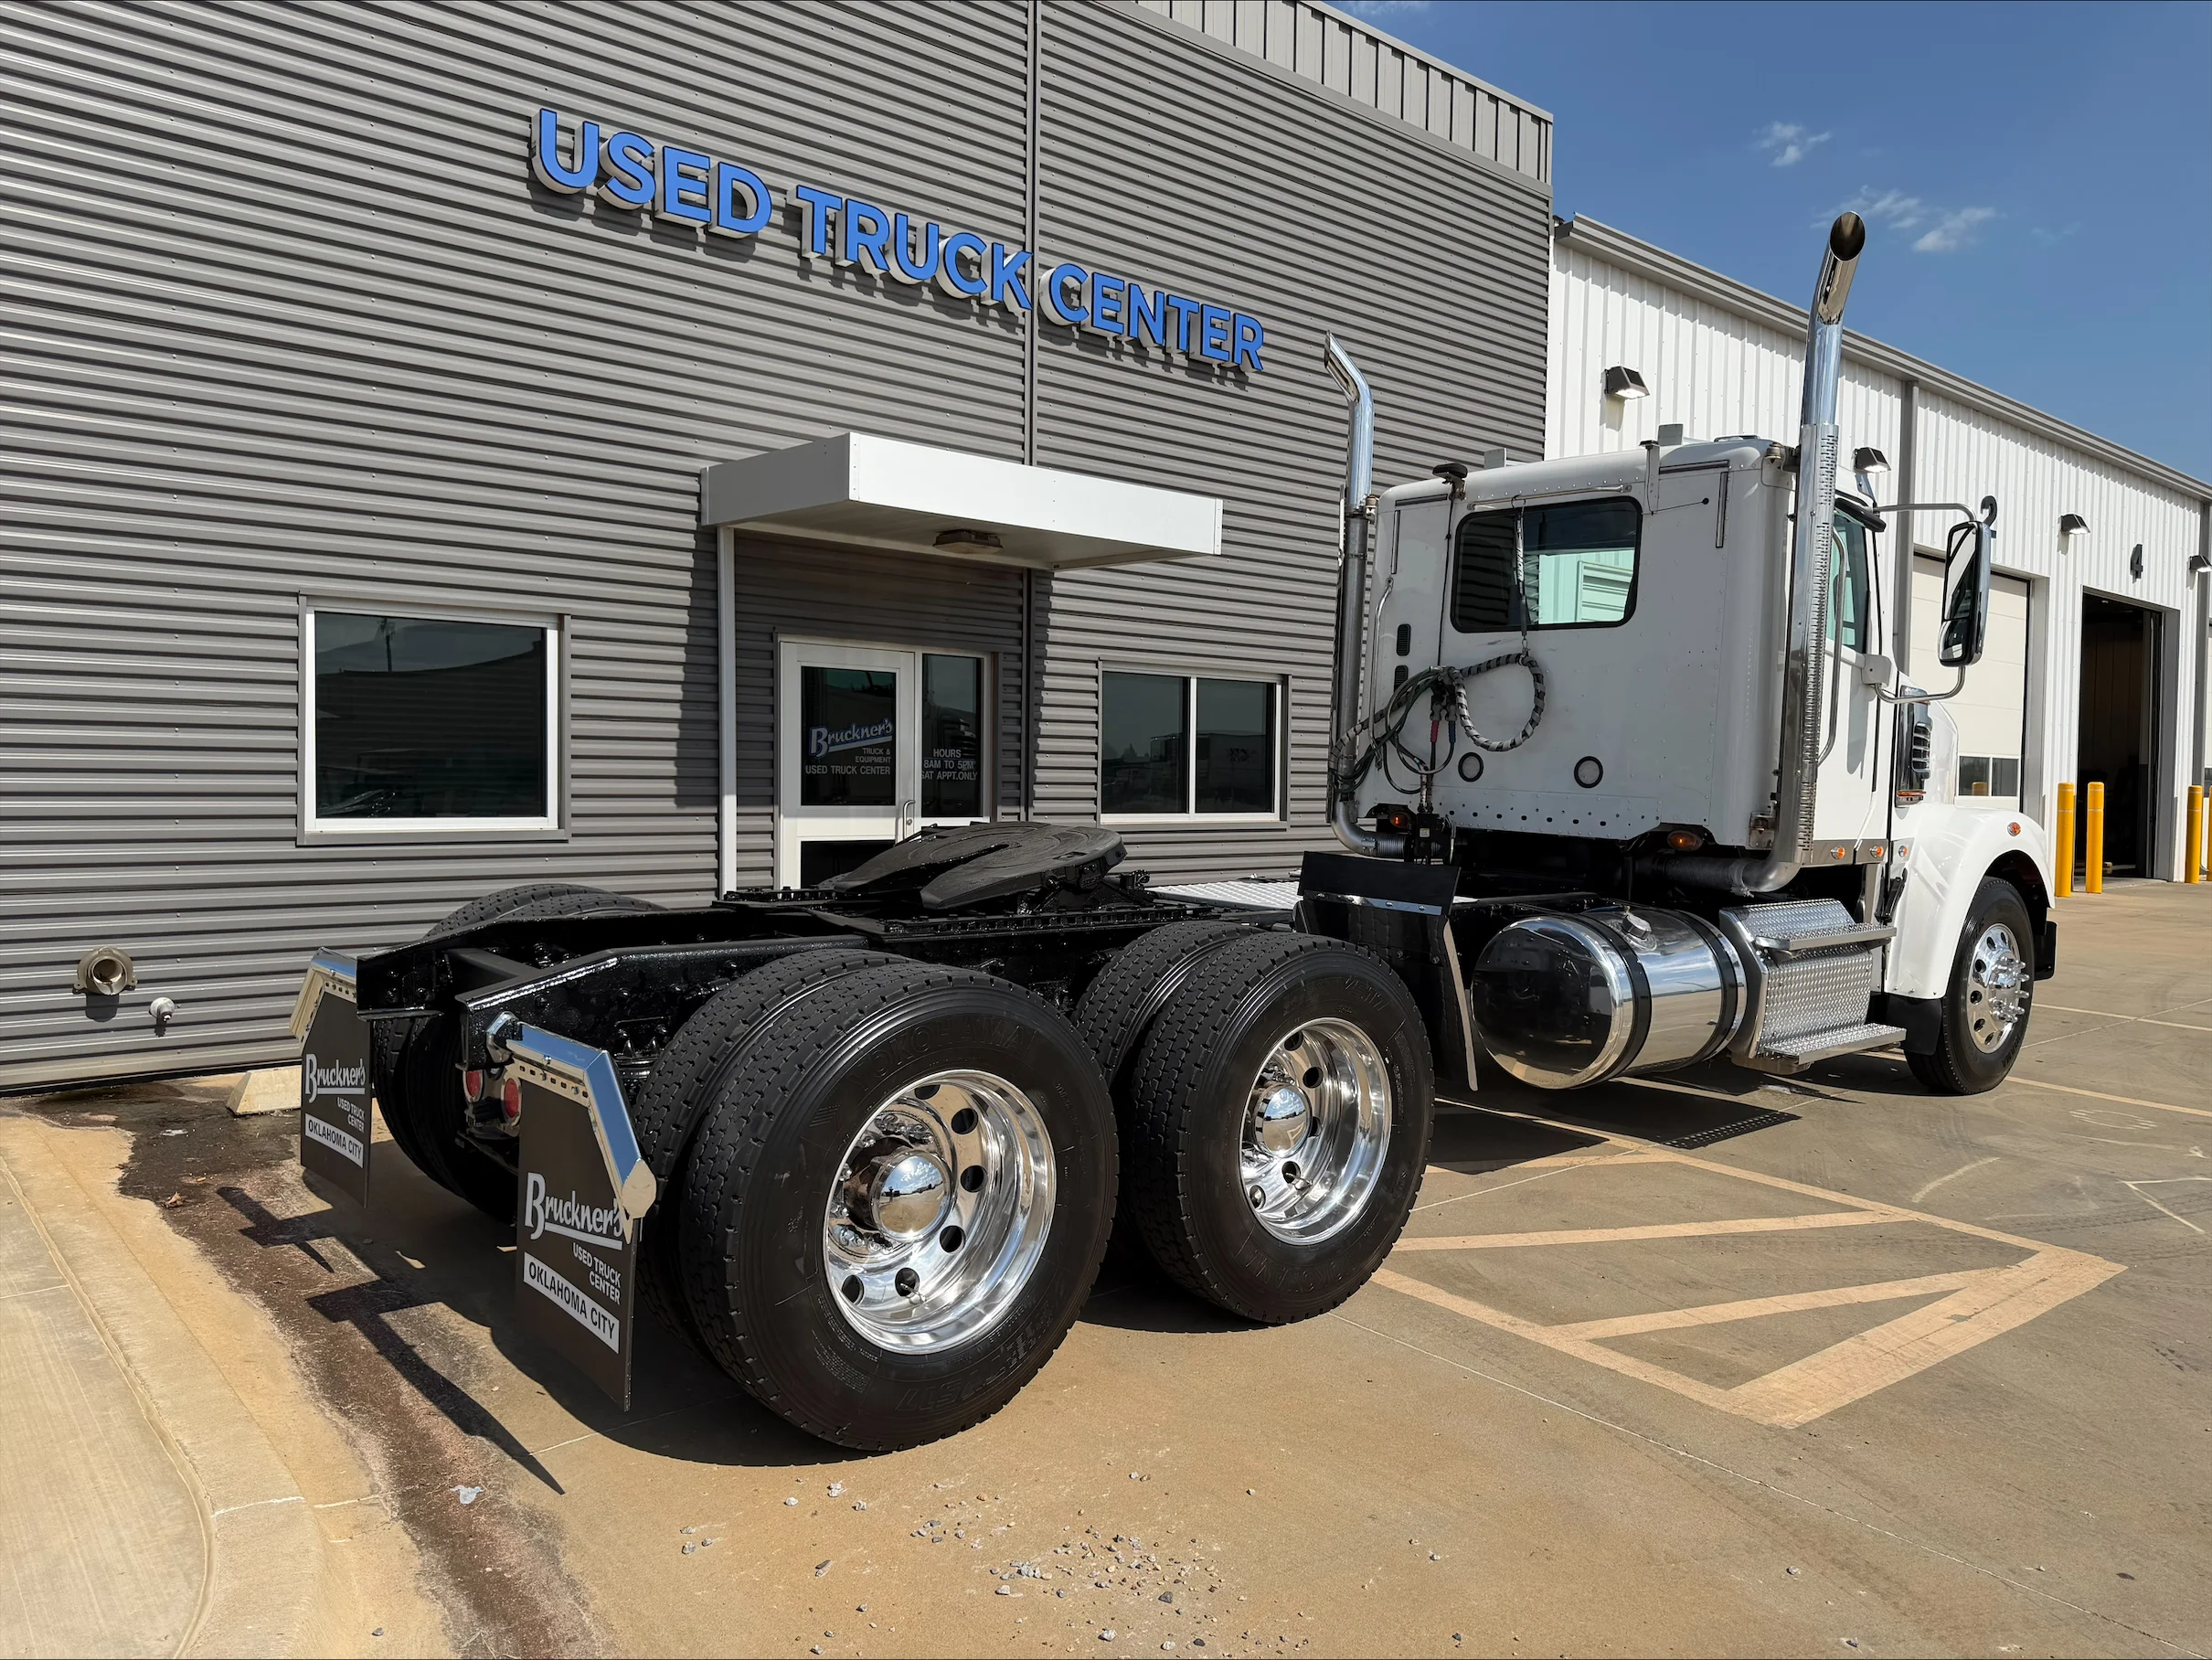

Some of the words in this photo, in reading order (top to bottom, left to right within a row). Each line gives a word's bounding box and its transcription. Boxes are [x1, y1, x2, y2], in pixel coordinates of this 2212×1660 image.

[537, 108, 772, 236] USED
[794, 184, 1034, 311] TRUCK
[1048, 262, 1264, 370] CENTER
[810, 718, 893, 758] Bruckner's
[933, 749, 962, 759] HOURS
[805, 765, 828, 775] USED
[831, 765, 858, 775] TRUCK
[860, 765, 891, 775] CENTER
[855, 756, 891, 765] EQUIPMENT
[924, 760, 941, 769] 8AM
[944, 760, 955, 769] TO
[305, 1053, 366, 1103] Bruckner's
[336, 1097, 351, 1112] USED
[350, 1103, 365, 1122] TRUCK
[347, 1113, 365, 1133] CENTER
[308, 1119, 346, 1151] OKLAHOMA
[347, 1139, 362, 1159] CITY
[524, 1172, 624, 1240] Bruckner's
[572, 1241, 593, 1268] USED
[593, 1257, 622, 1288] TRUCK
[528, 1261, 588, 1320] OKLAHOMA
[590, 1306, 615, 1340] CITY
[589, 1271, 621, 1305] CENTER
